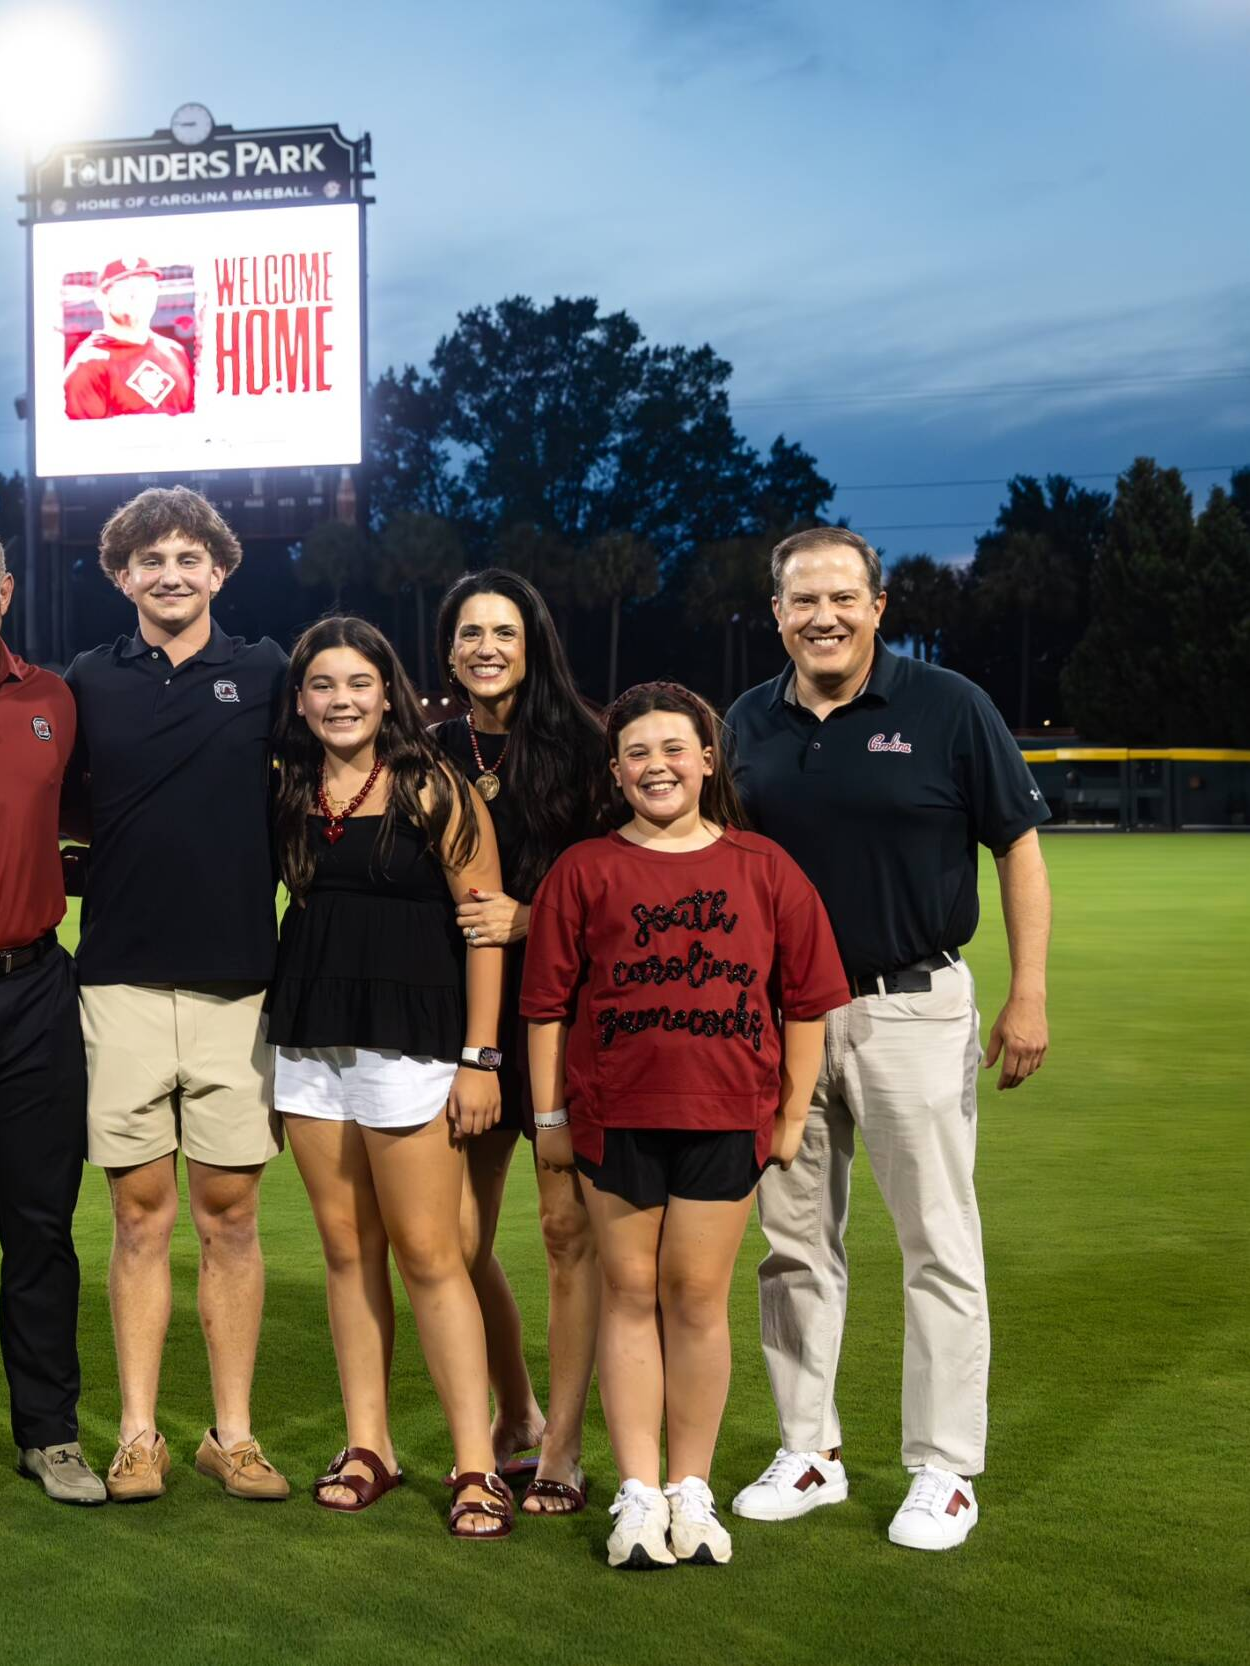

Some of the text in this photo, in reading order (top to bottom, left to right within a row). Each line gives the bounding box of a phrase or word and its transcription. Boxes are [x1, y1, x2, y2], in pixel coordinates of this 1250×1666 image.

[235, 142, 326, 177] PARK
[76, 184, 313, 212] HOME OF CAROLINA BASEBALL
[215, 252, 333, 306] WELCOME
[216, 306, 333, 395] HOME
[613, 941, 757, 988] carolina
